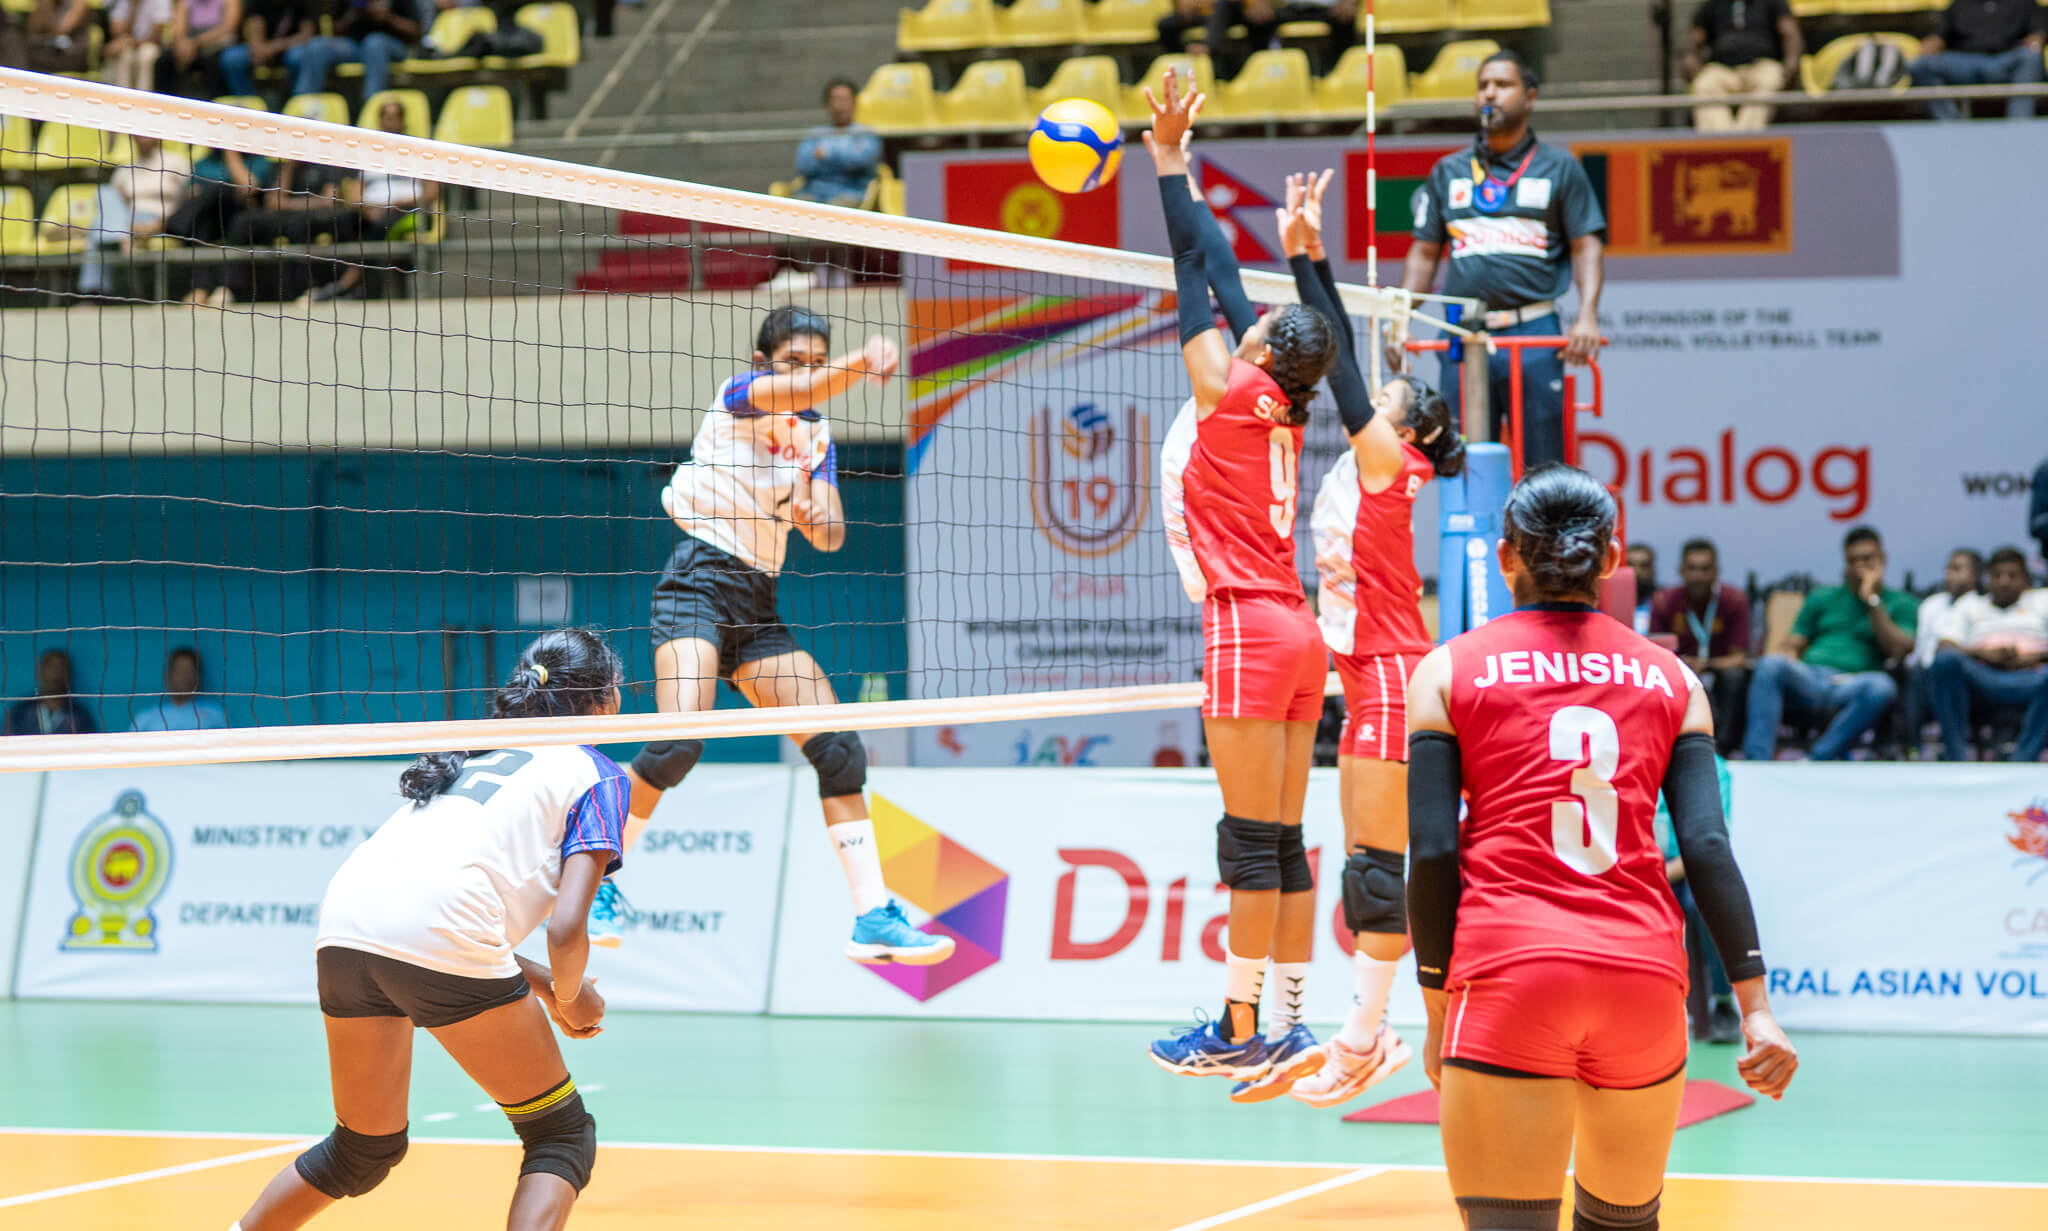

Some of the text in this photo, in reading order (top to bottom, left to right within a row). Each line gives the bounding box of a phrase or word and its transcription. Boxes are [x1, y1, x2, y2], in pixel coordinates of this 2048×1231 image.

[1624, 309, 1715, 327] SPONSOR
[1722, 309, 1748, 326] OF
[1754, 307, 1791, 325] THE
[1690, 330, 1816, 348] VOLLEYBALL
[1825, 328, 1882, 346] TEAM
[1269, 426, 1297, 538] 9
[1576, 427, 1871, 522] Dialog
[1063, 476, 1116, 520] 19
[1473, 650, 1674, 697] JENISHA
[441, 749, 534, 806] 2
[1549, 705, 1620, 876] 3
[192, 825, 311, 847] MINISTRY
[318, 826, 353, 848] OF
[643, 829, 753, 854] SPORTS
[1766, 968, 2048, 999] RAL ASIAN VOL
